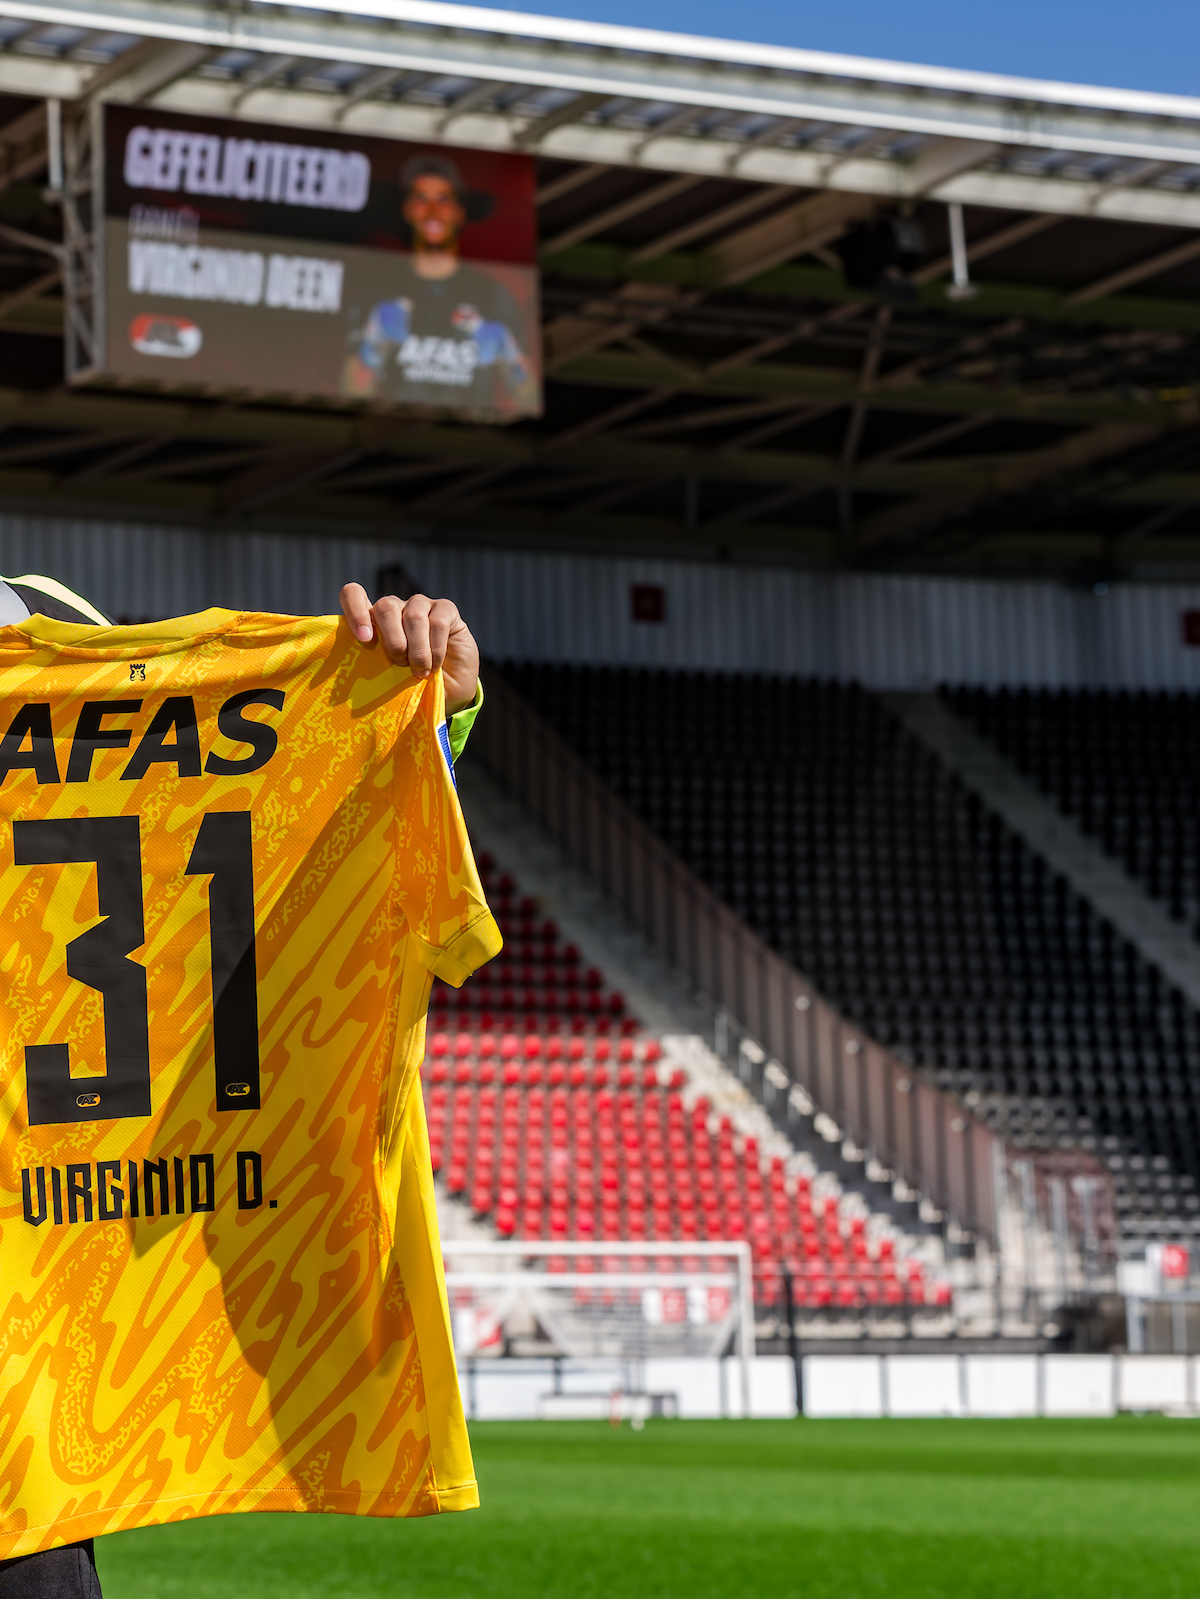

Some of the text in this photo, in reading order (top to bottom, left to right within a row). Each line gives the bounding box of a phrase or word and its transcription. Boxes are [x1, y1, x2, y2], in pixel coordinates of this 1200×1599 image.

[124, 126, 371, 212] GEFELICITEERD
[12, 811, 261, 1126] 31
[21, 1150, 278, 1228] VIRGINIO D.
